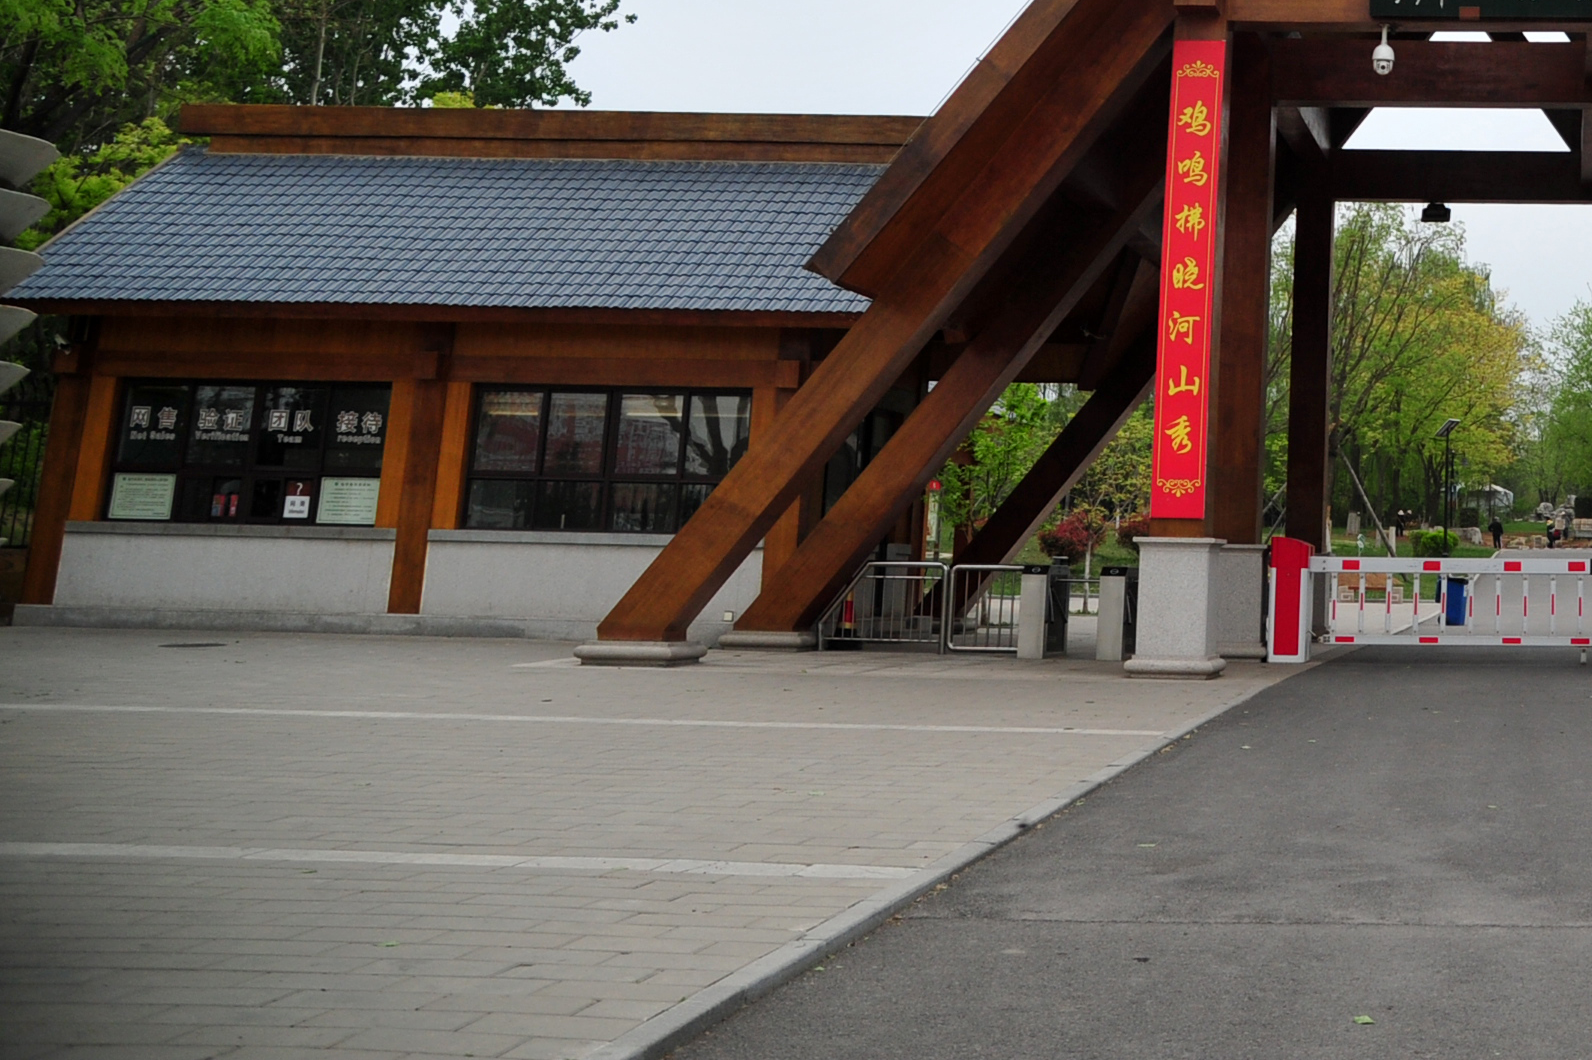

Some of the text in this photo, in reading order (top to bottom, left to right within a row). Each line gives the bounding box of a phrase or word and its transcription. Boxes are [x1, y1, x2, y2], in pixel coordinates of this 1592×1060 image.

[1164, 99, 1211, 455] 鸡鸣拂晓河山秀
